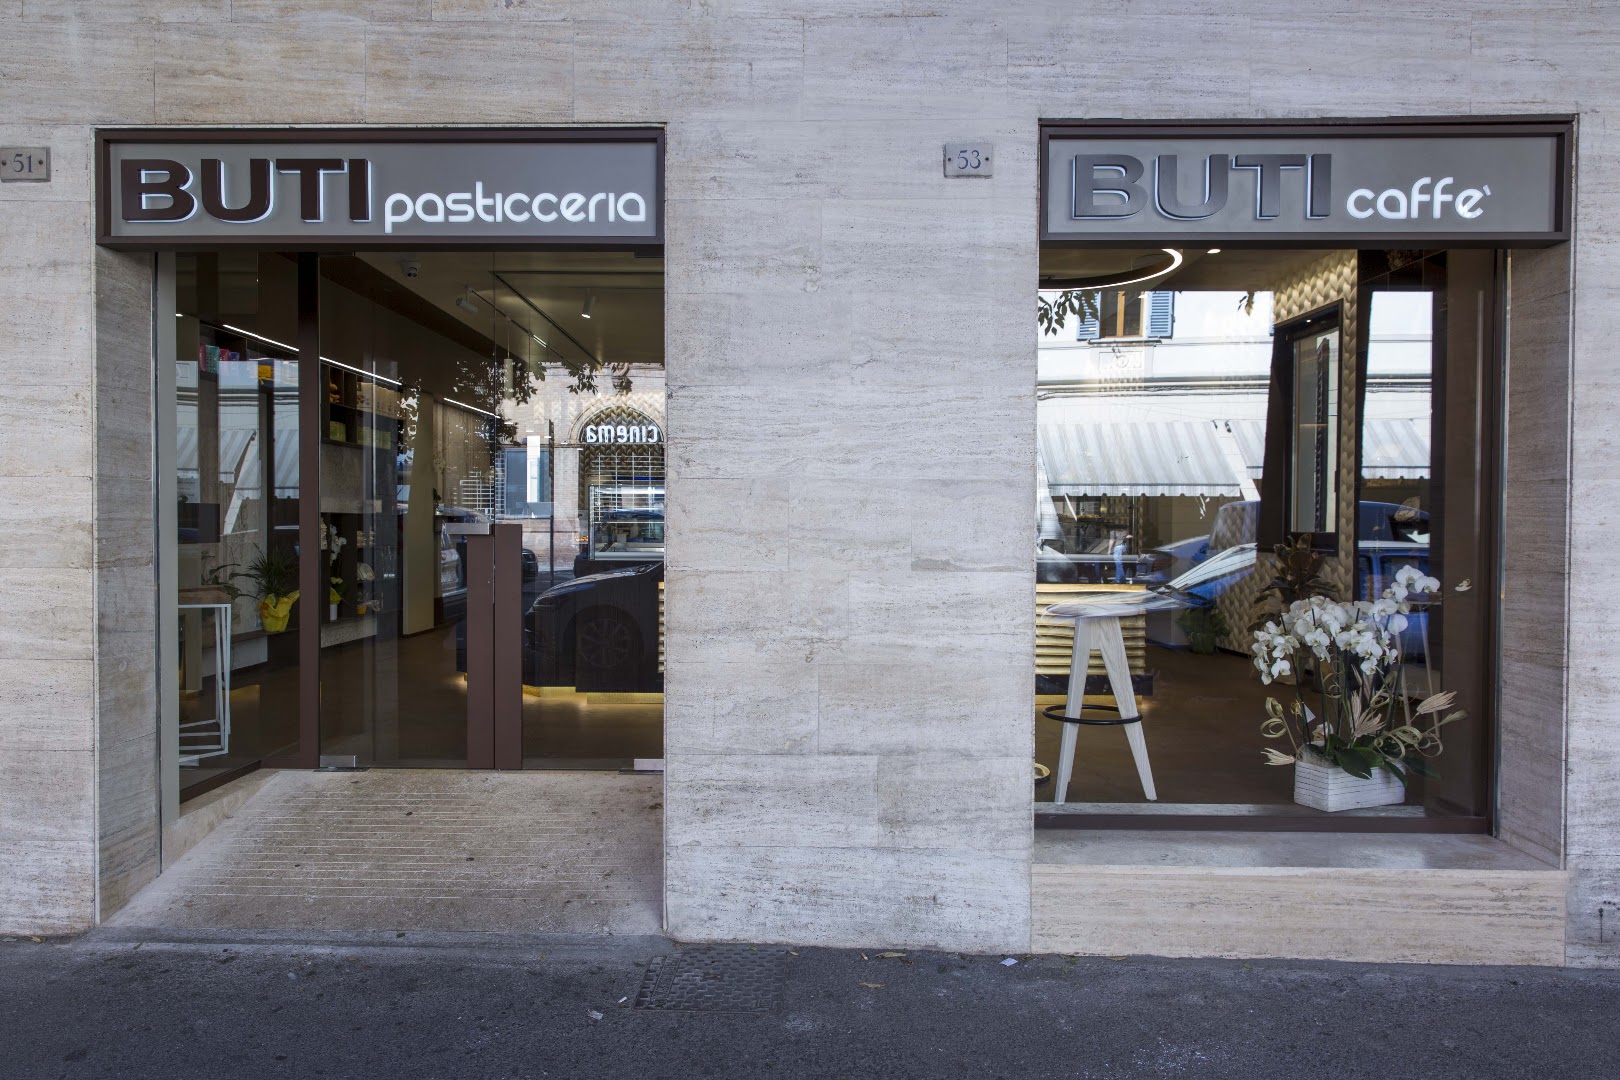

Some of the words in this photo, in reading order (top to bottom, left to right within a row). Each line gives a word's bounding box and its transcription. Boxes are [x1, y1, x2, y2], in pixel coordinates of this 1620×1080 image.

[12, 153, 33, 173] 51
[957, 149, 981, 170] 53
[120, 158, 372, 223] BUTI
[384, 181, 647, 234] pasticceria
[1072, 153, 1332, 220] BUTI
